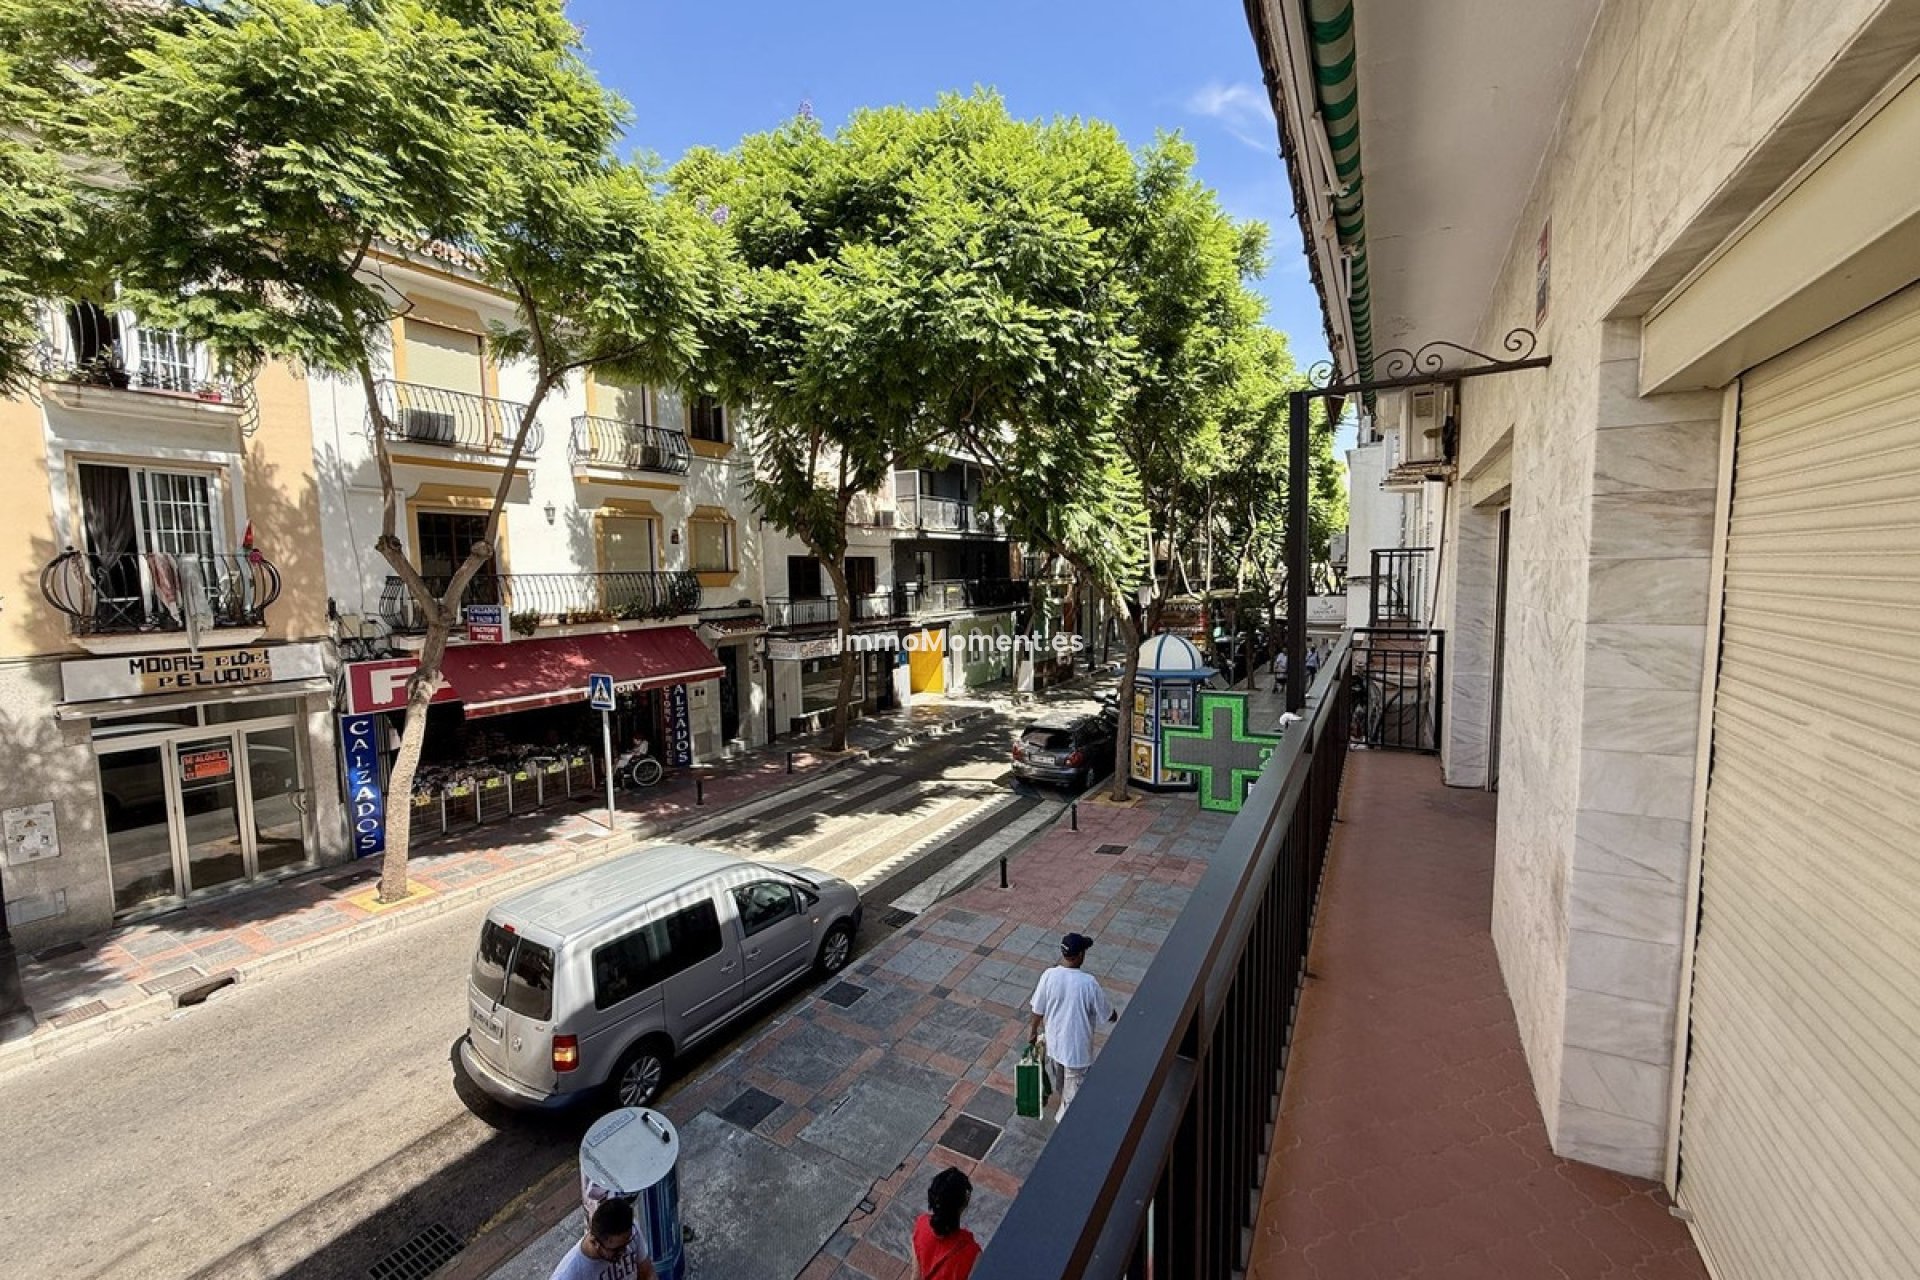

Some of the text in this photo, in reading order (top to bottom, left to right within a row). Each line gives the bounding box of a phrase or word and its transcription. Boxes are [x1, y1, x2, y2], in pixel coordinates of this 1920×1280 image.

[663, 685, 672, 723] CTORY
[673, 684, 689, 763] ALZADOS
[350, 721, 378, 849] CALZADOS
